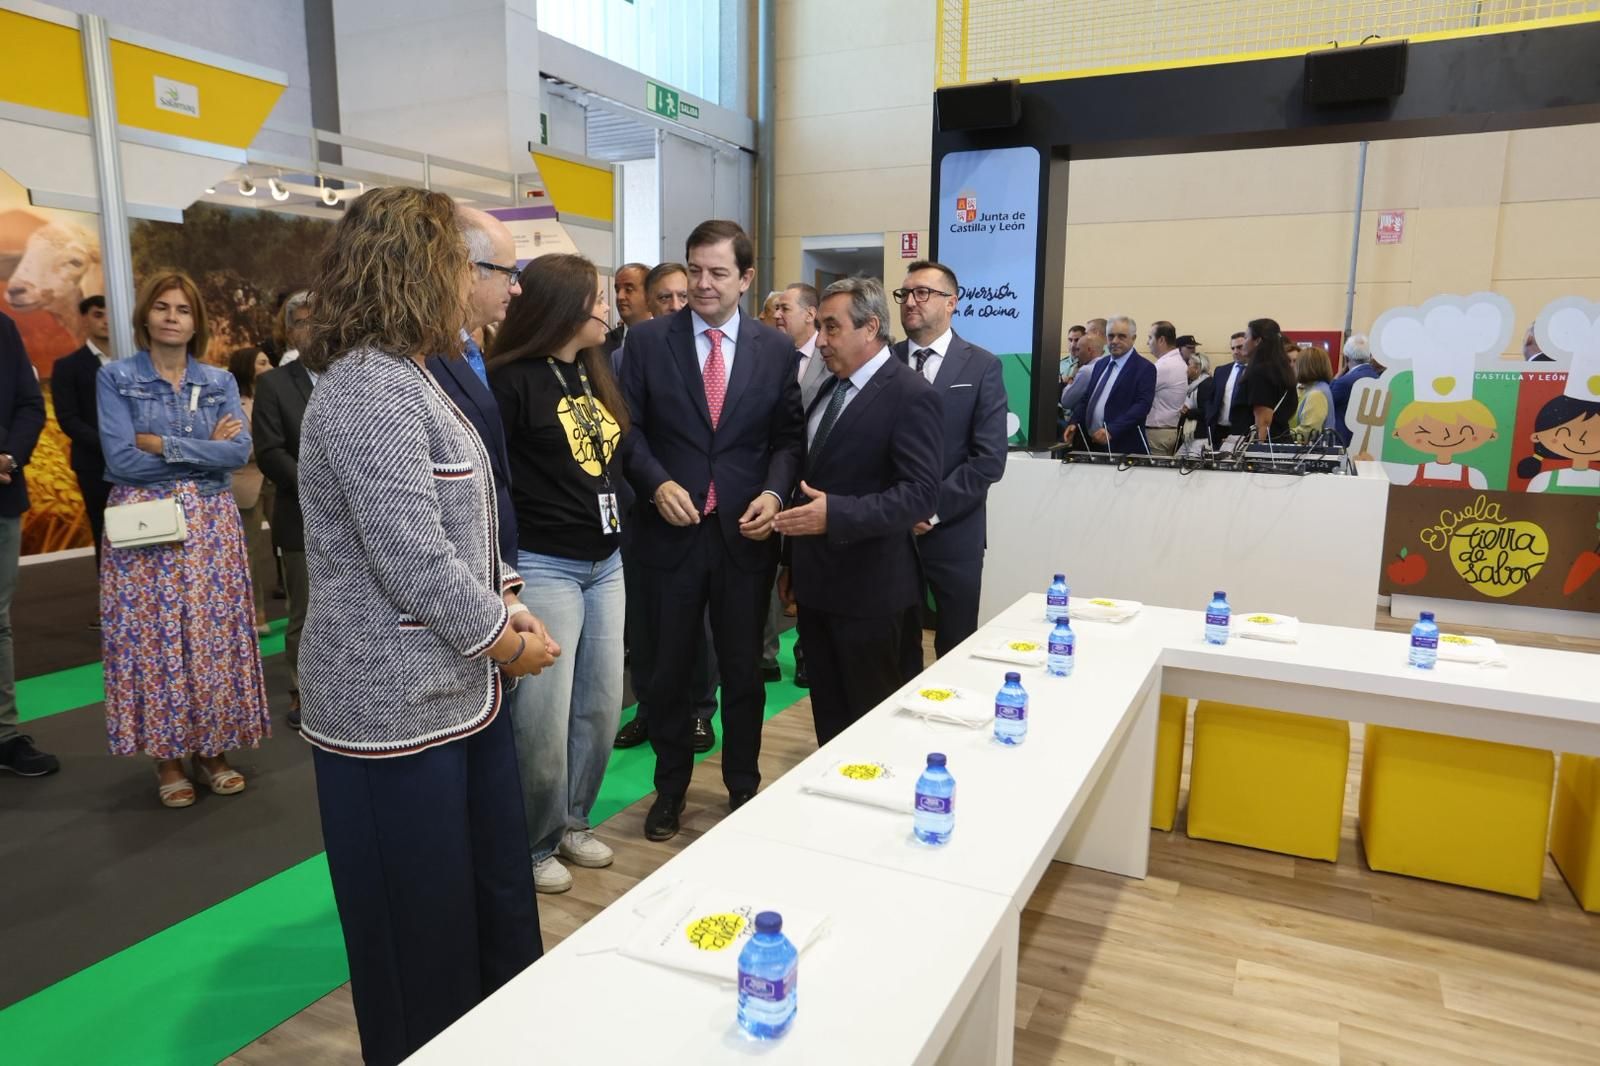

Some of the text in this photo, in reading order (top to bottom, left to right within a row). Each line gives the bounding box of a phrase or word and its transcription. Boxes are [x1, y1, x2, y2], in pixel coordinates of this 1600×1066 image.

[979, 211, 1026, 222] Junta de
[950, 221, 1025, 234] Castilla y León
[963, 304, 974, 317] la
[1475, 372, 1566, 381] CASTILLA Y LEÓN
[575, 431, 621, 464] saor
[1420, 494, 1507, 551] Escuela
[1455, 527, 1545, 556] tierra
[1458, 548, 1487, 563] de
[1462, 550, 1544, 586] sabor
